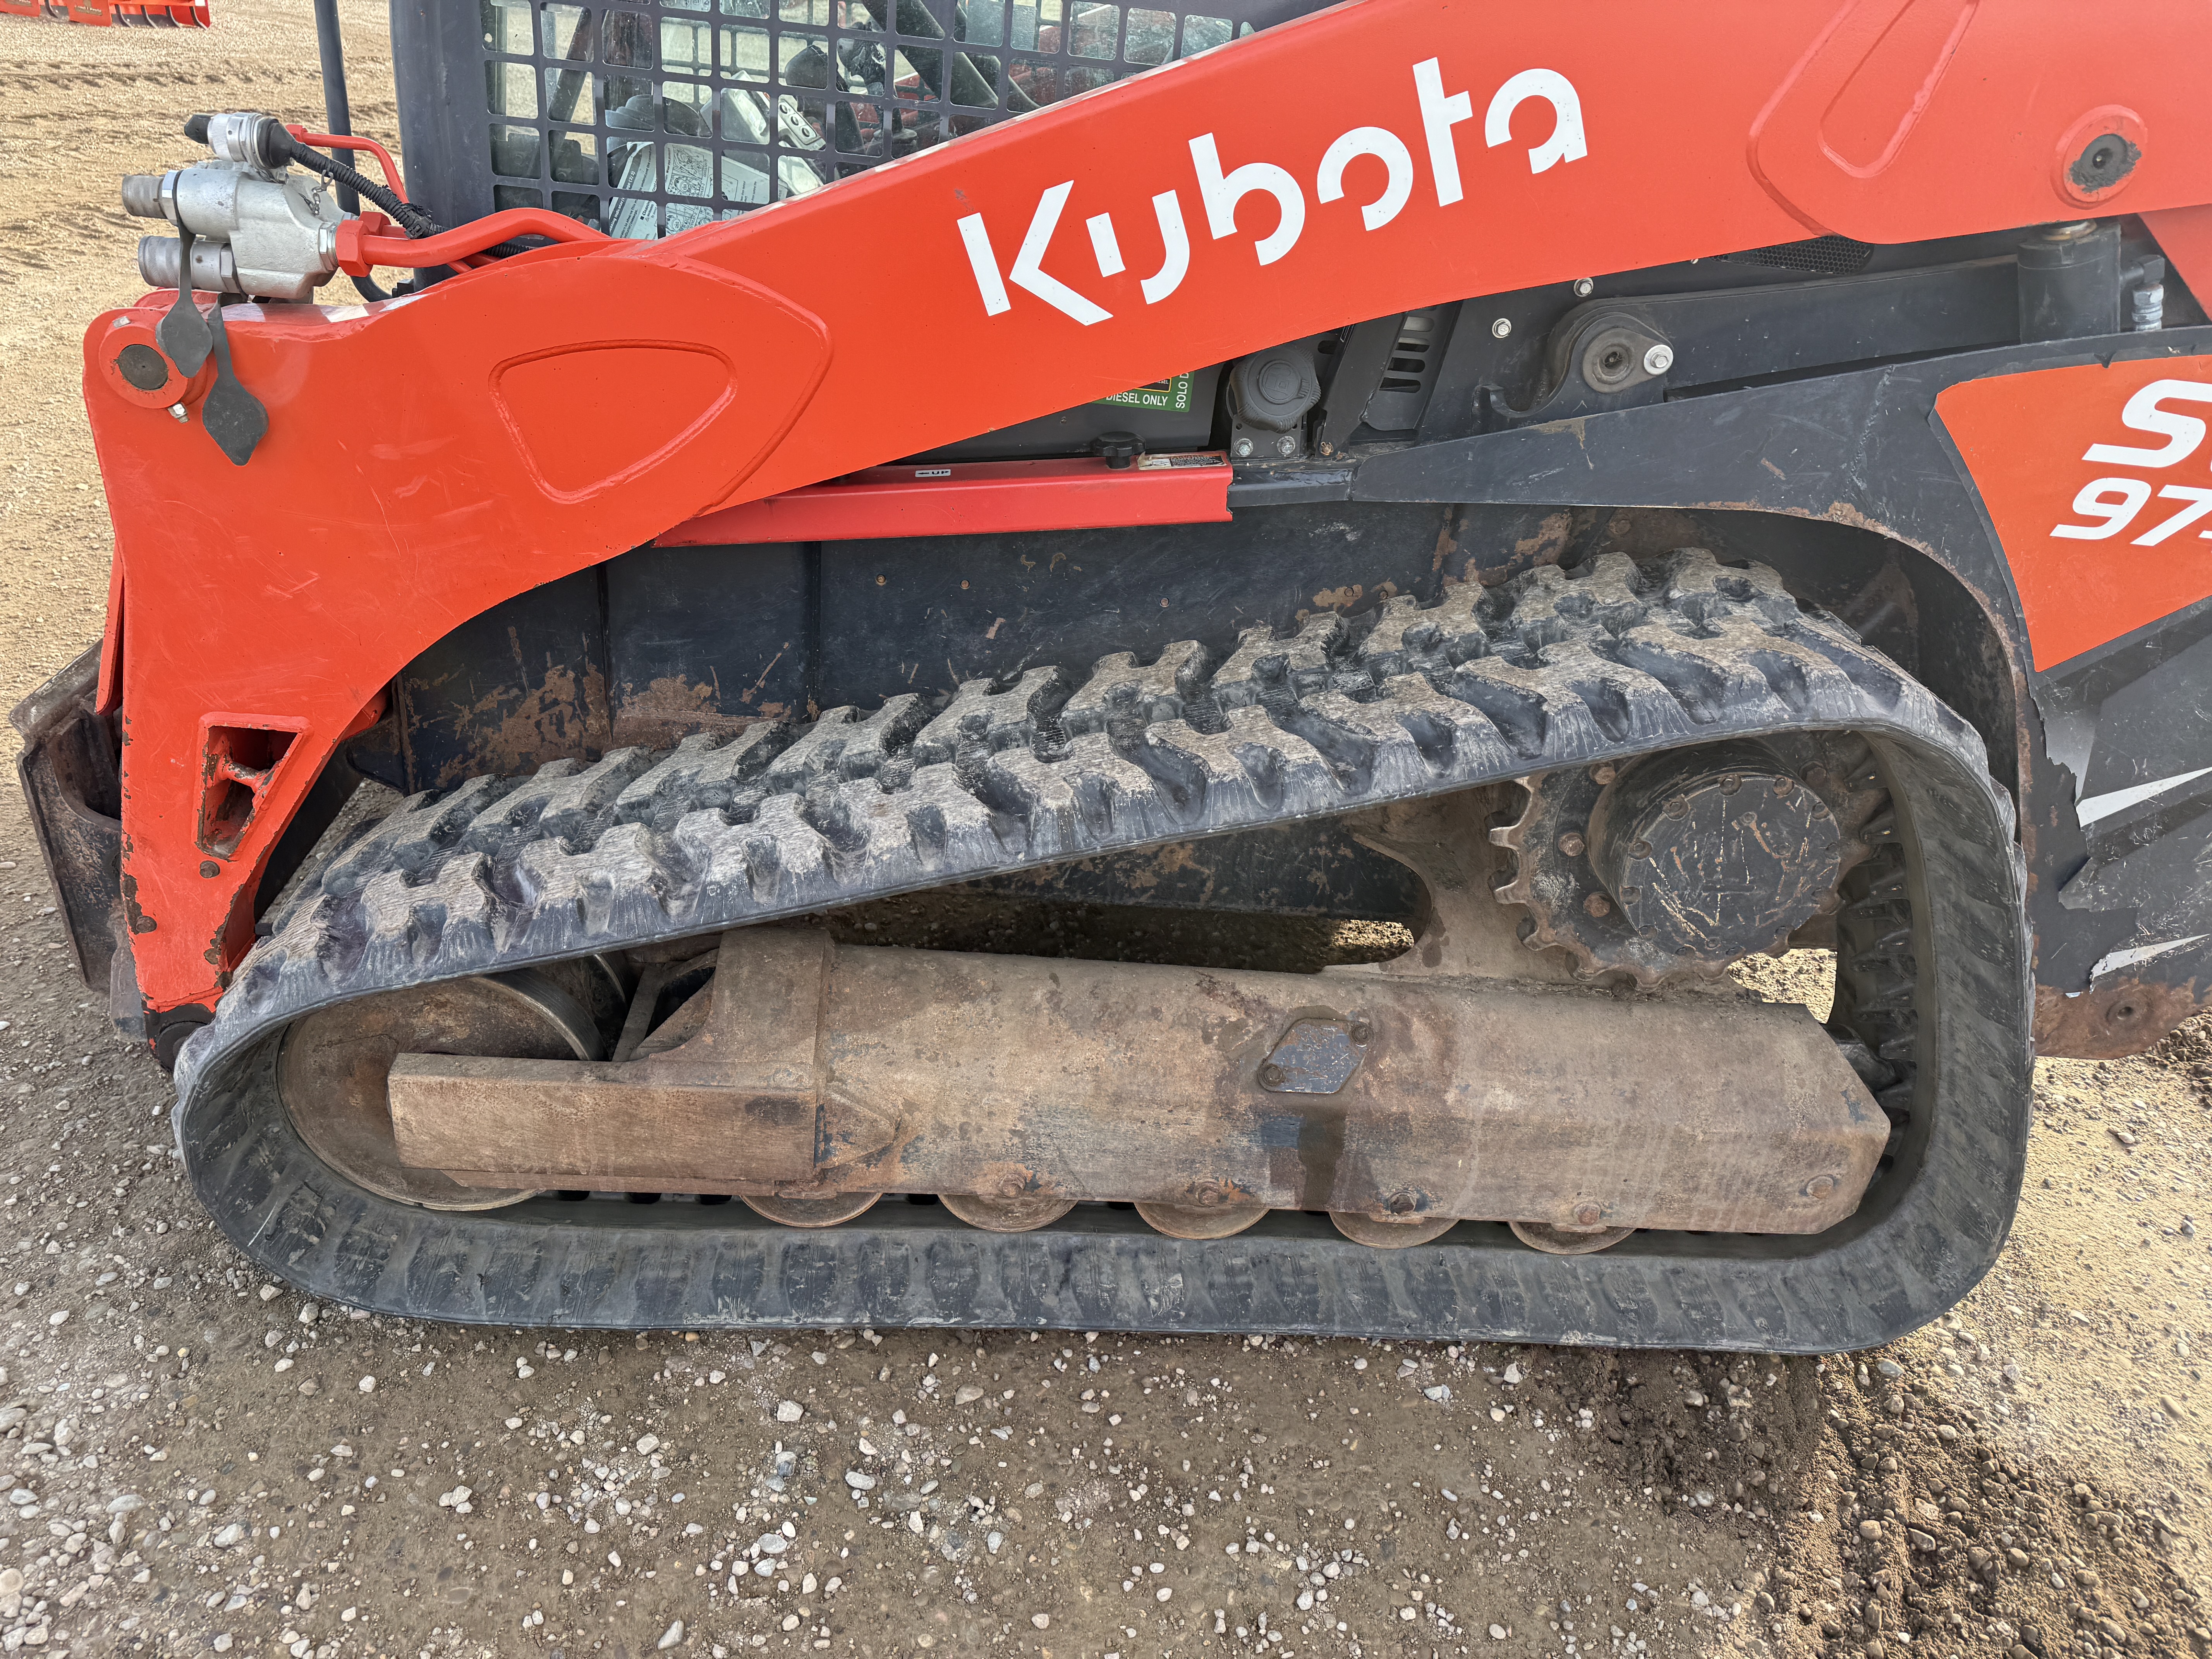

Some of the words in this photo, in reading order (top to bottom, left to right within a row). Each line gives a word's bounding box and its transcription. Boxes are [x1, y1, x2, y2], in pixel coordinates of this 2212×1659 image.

[957, 57, 1588, 326] Kubota
[1143, 394, 1168, 406] ONLY
[1176, 381, 1188, 409] SOLO
[2050, 477, 2212, 546] 97
